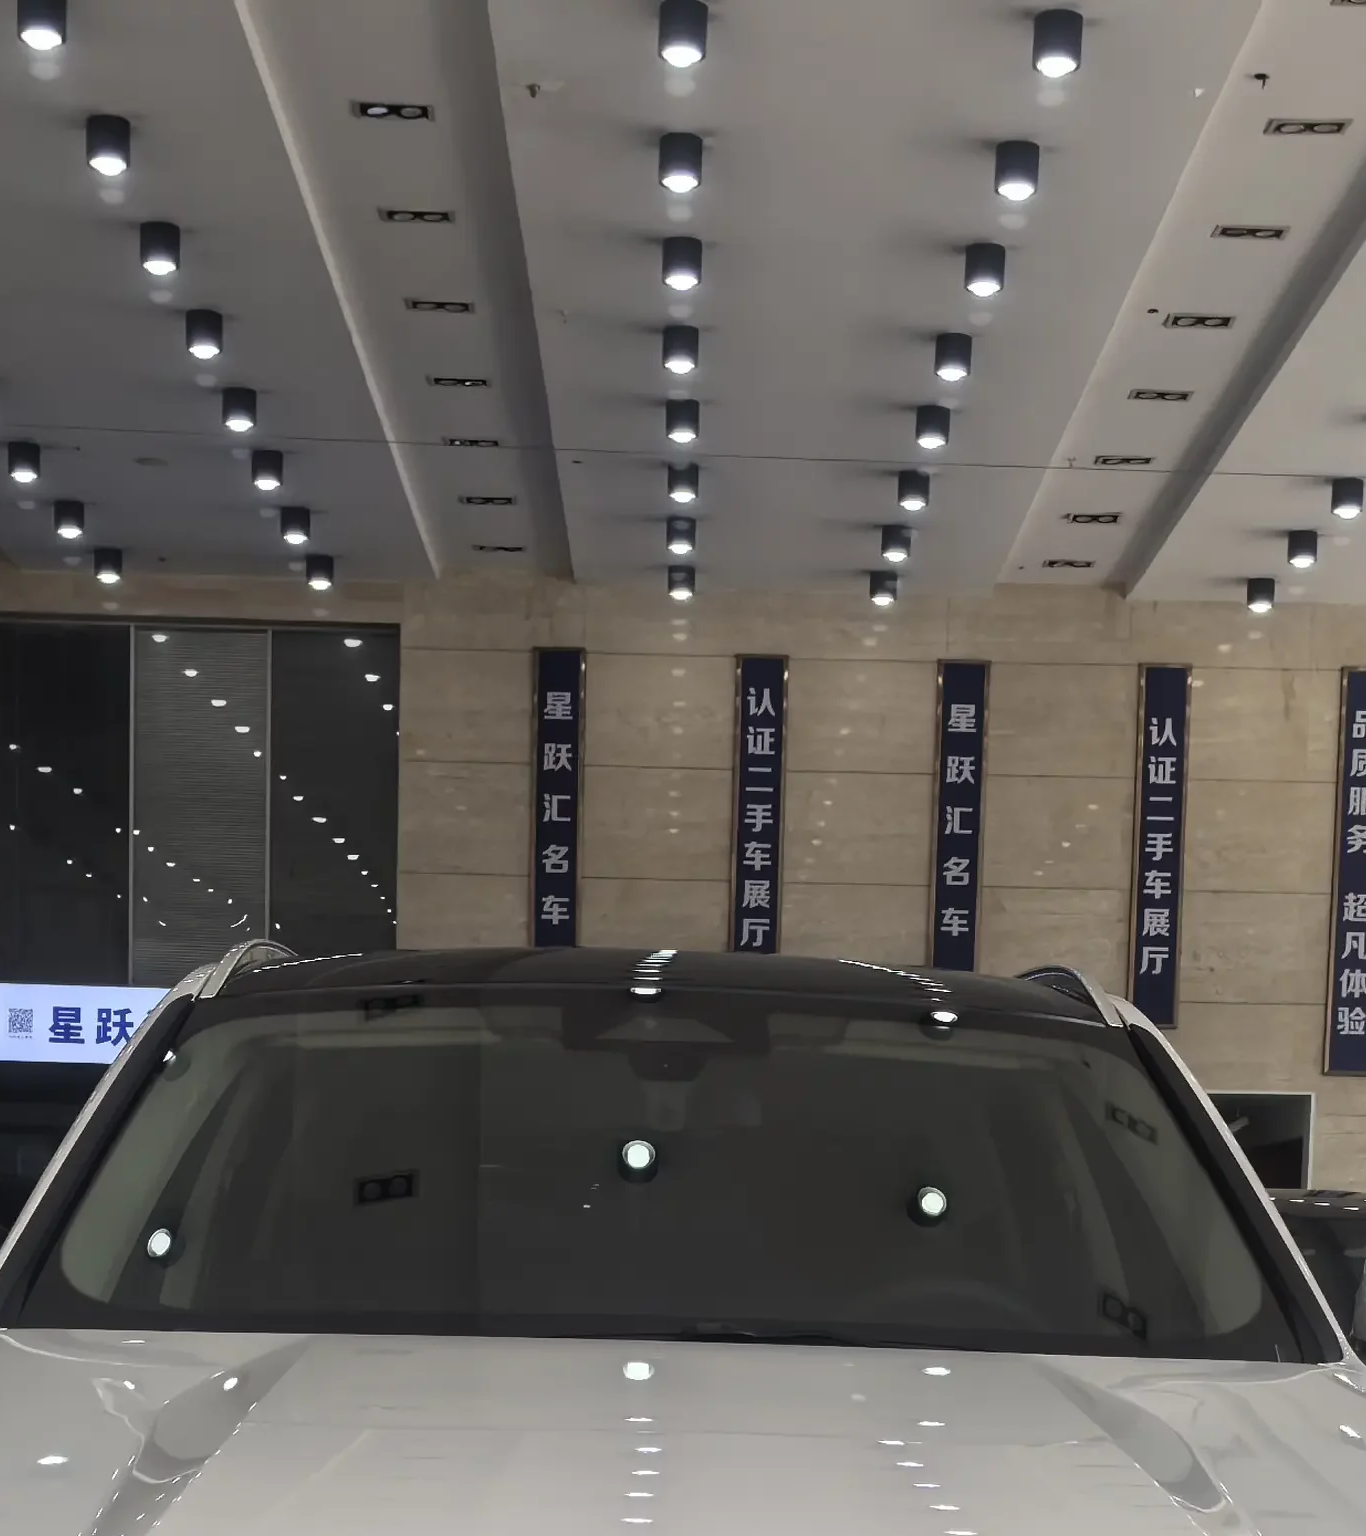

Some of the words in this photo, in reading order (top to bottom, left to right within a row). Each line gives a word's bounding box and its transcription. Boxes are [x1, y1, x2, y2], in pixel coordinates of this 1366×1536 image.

[541, 690, 574, 925] 星跃汇名车
[740, 687, 776, 947] 认证二手车展厅
[940, 703, 977, 937] 星跃汇名车
[1139, 717, 1178, 976] 认证二手车展厅
